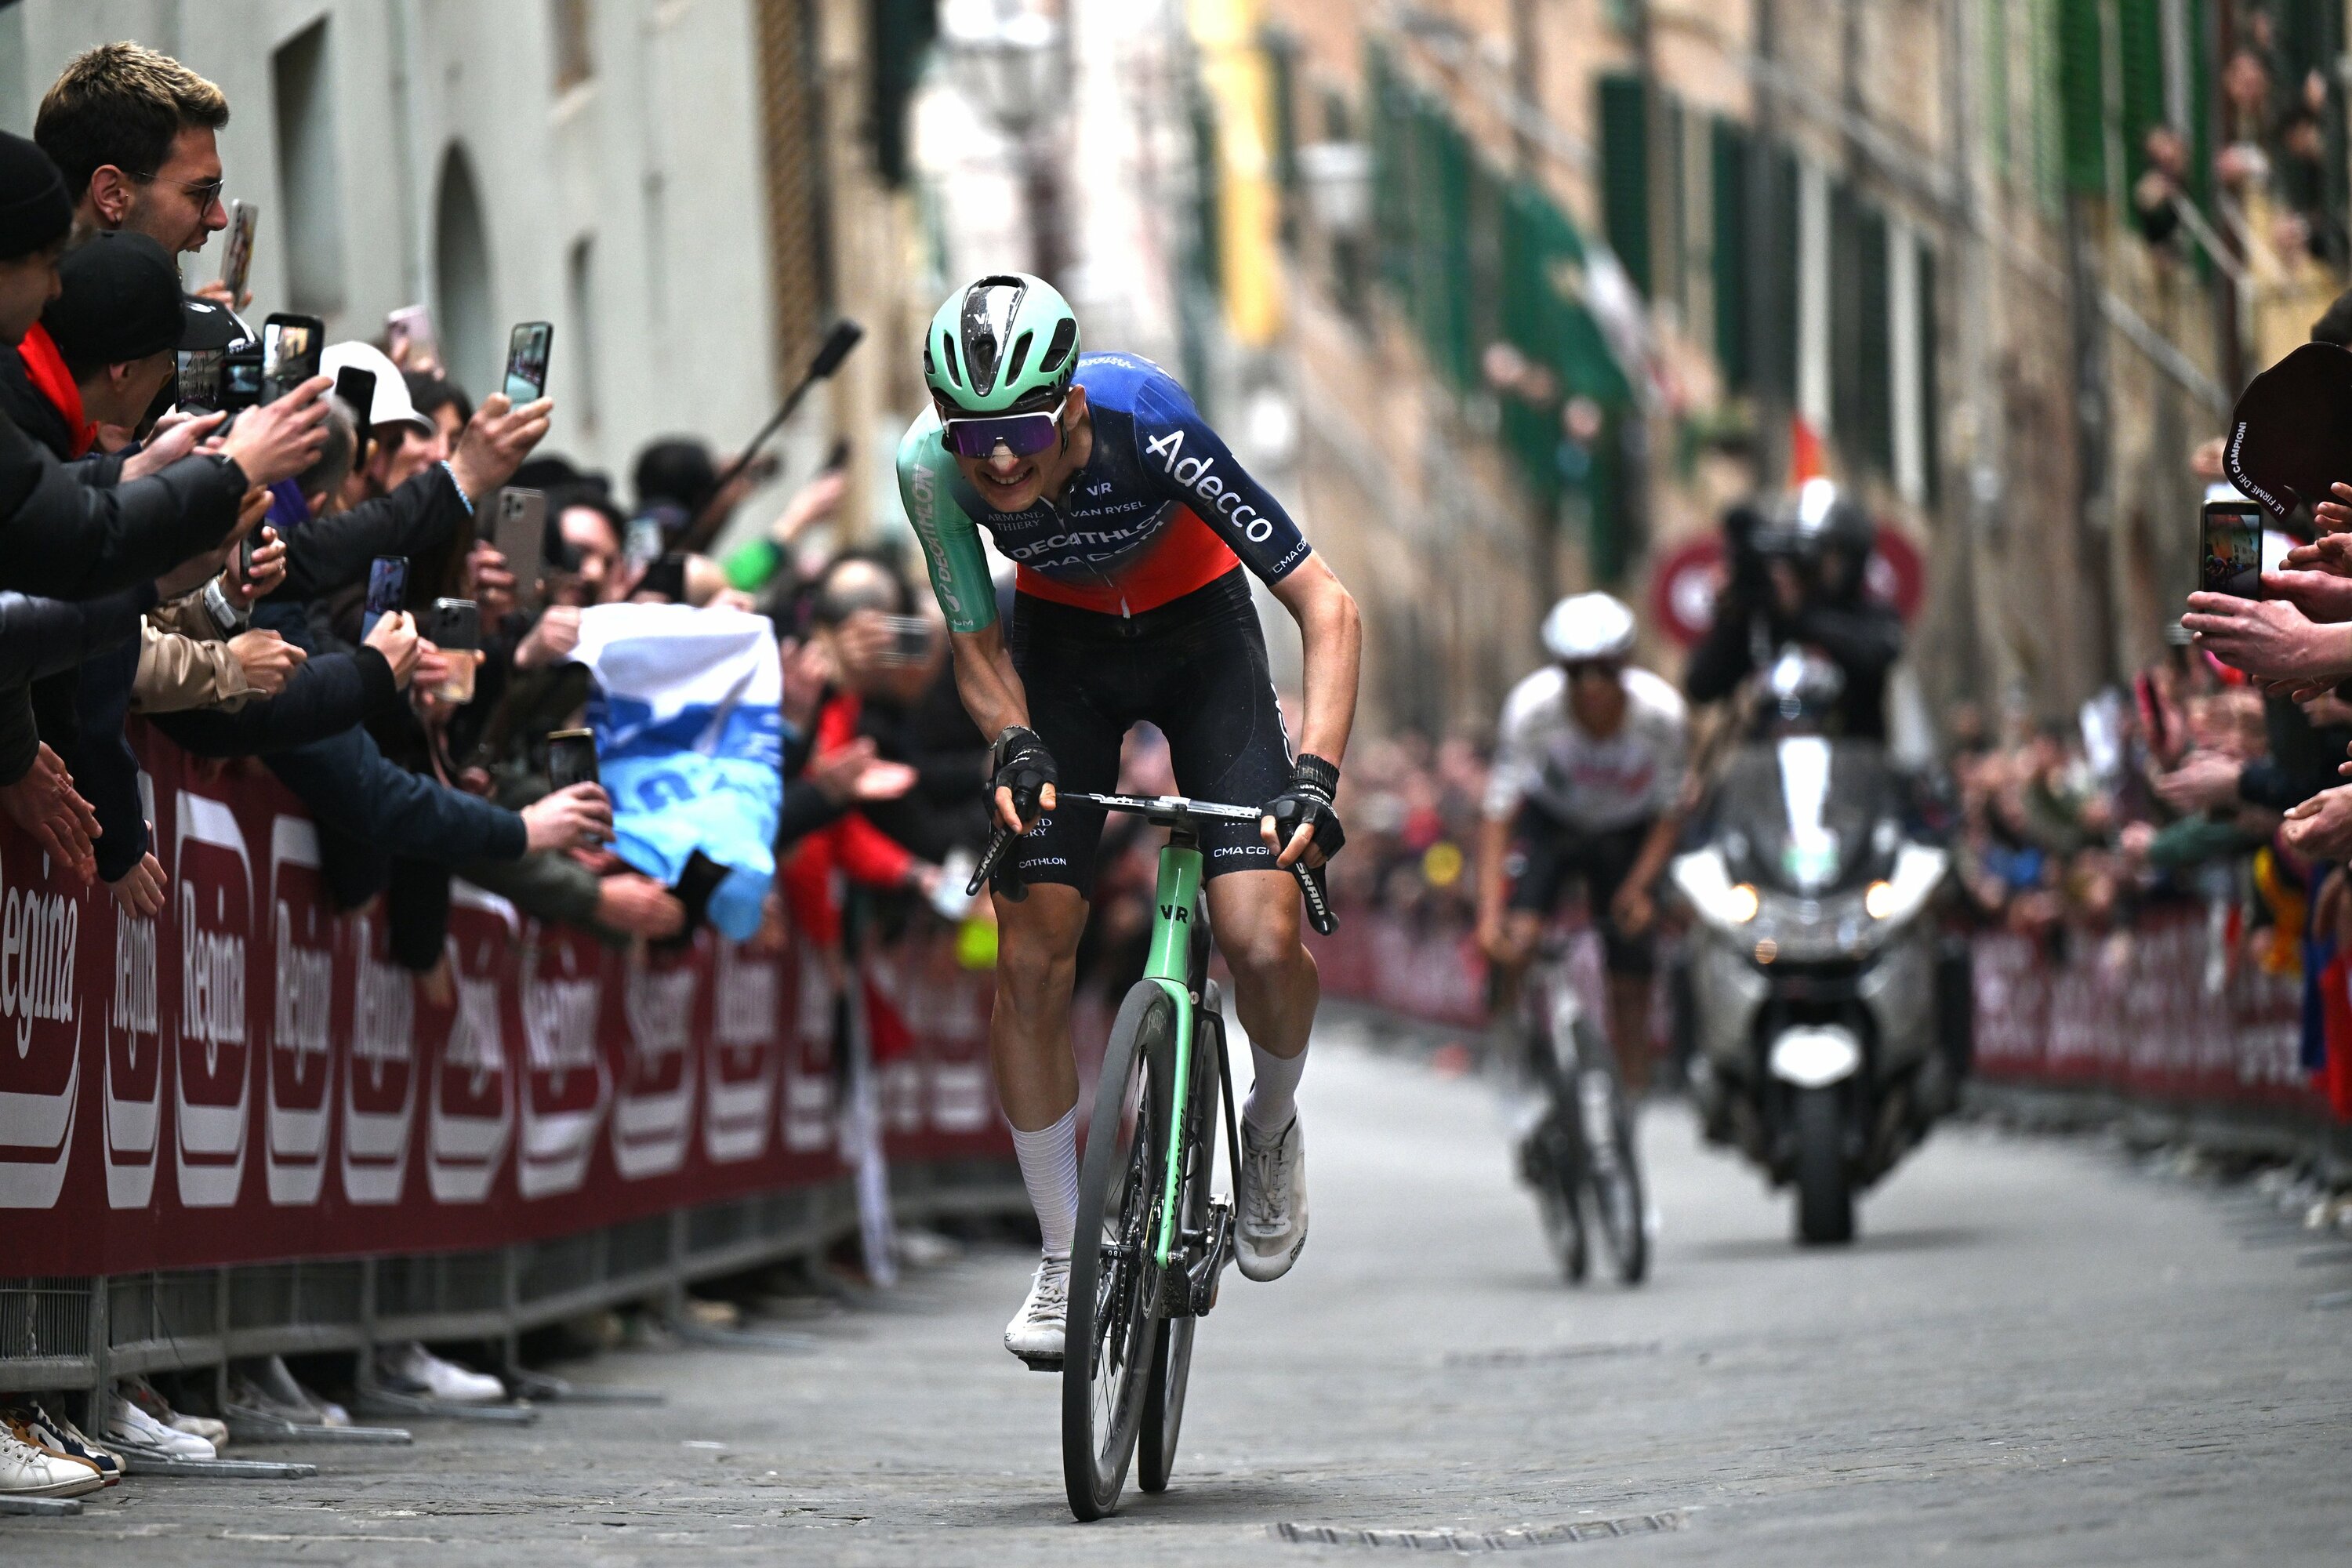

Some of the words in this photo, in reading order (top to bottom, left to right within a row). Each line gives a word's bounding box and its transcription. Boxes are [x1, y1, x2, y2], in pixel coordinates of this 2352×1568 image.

[2230, 422, 2247, 474] CAMPIONI
[1145, 430, 1273, 543] Adecco
[2237, 474, 2252, 488] DEI
[2251, 485, 2277, 506] FIRME
[1070, 508, 1102, 517] VAN
[1105, 500, 1147, 514] RYSEL
[2274, 503, 2285, 515] LE
[995, 519, 1041, 532] THIERY
[1272, 550, 1298, 573] CMA
[1296, 535, 1308, 552] CG
[1214, 846, 1244, 857] CMA
[1246, 846, 1269, 856] CG
[1295, 862, 1325, 916] SRAM
[1160, 905, 1189, 924] VR
[0, 849, 78, 1059] egina
[183, 879, 245, 1080] Regina
